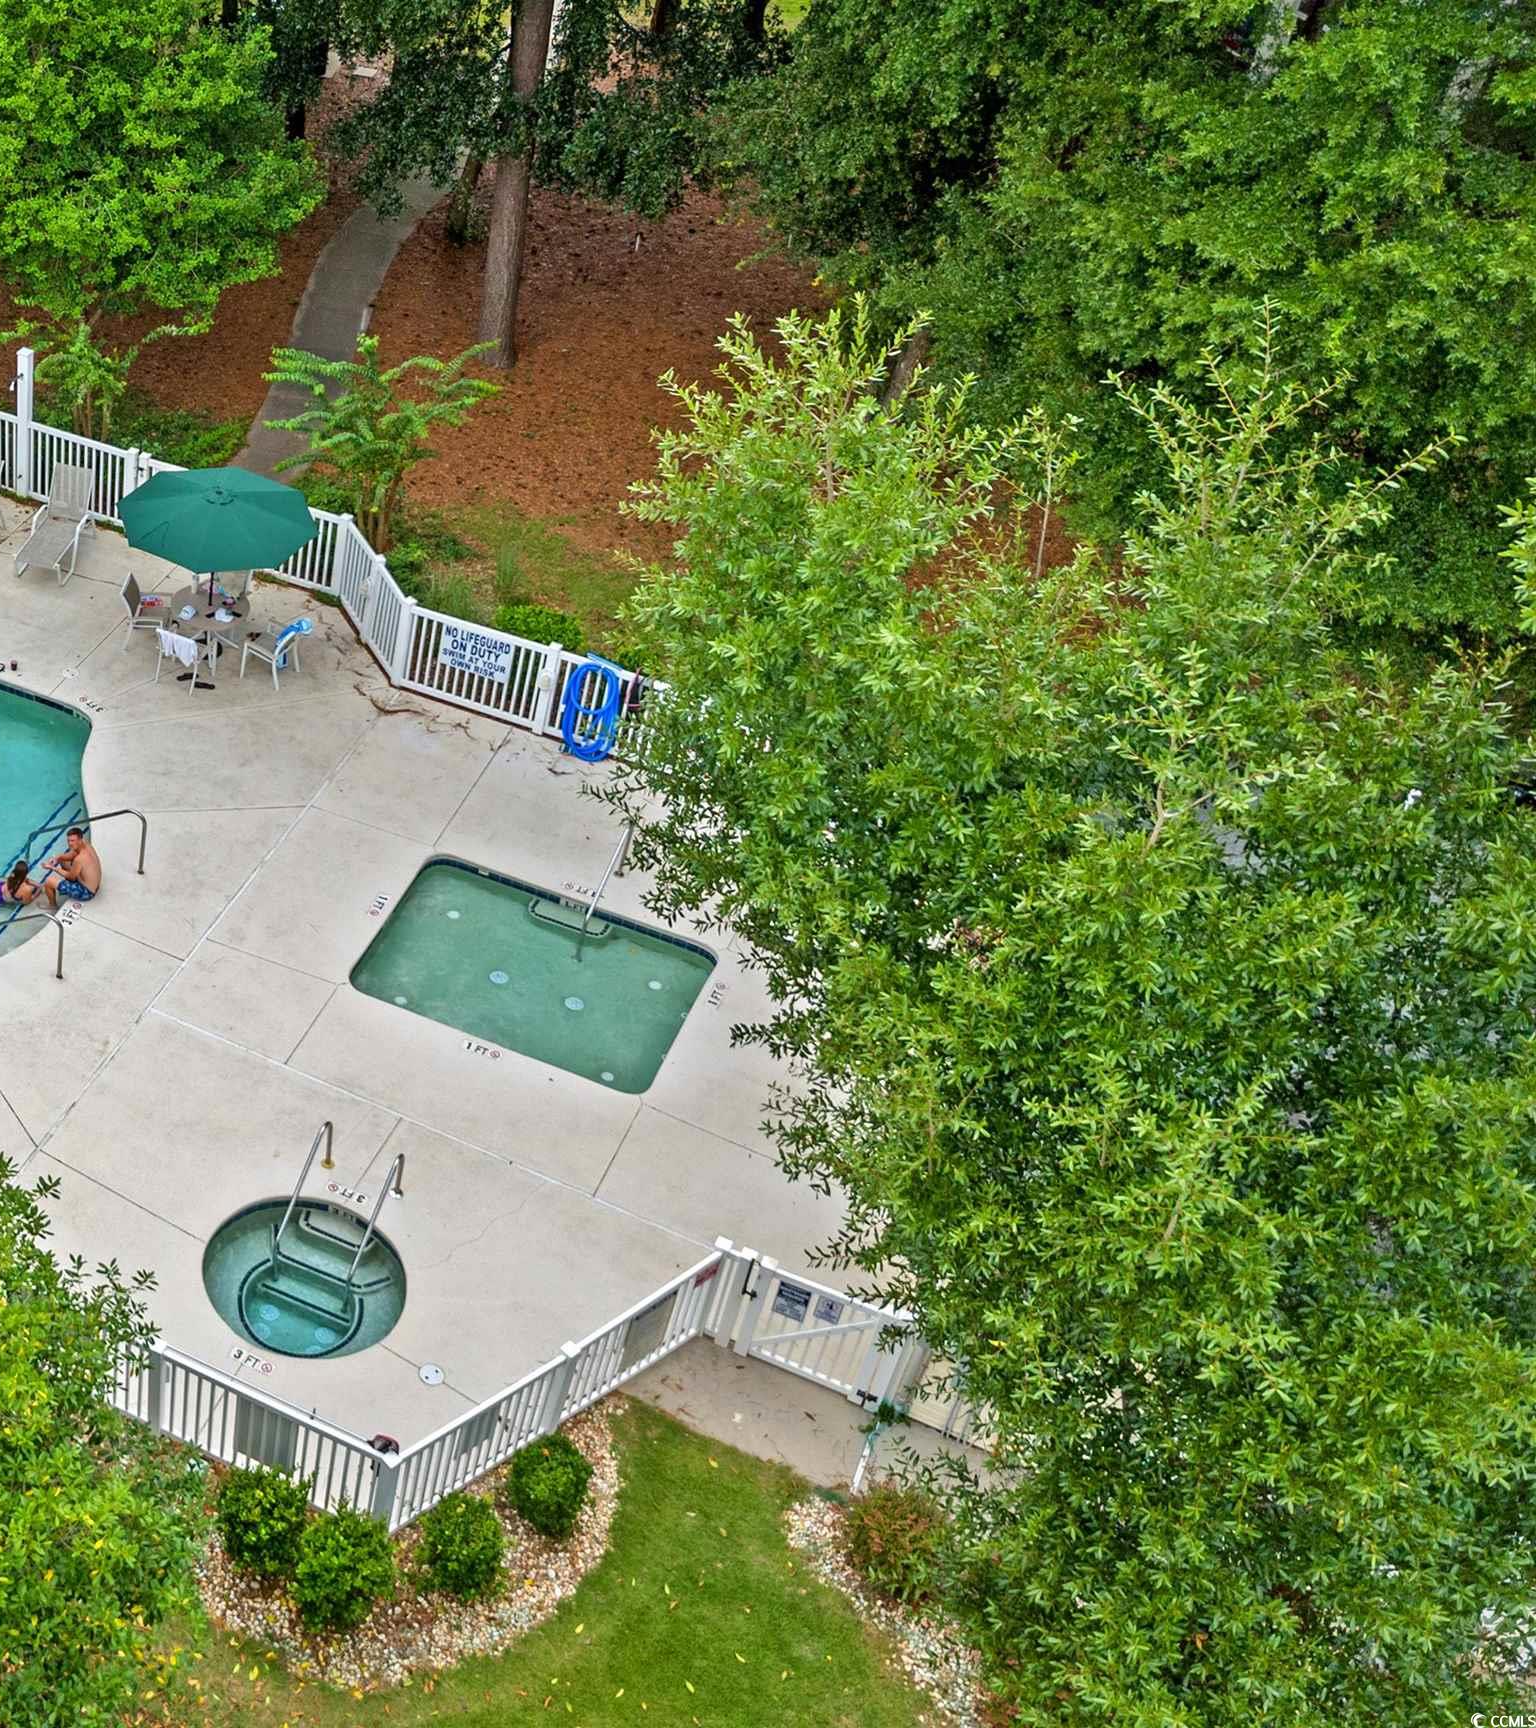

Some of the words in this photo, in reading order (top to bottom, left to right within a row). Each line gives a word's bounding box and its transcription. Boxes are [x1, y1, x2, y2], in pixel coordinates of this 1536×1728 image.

[445, 625, 458, 638] NO
[461, 630, 511, 654] LIFEGUARD
[442, 648, 465, 659] SWIM
[468, 656, 479, 665] AT
[482, 660, 506, 673] YOUR
[451, 639, 467, 652] ON
[471, 645, 501, 663] DUTY
[450, 659, 471, 670] OWN
[474, 666, 495, 678] RISK
[340, 1188, 354, 1199] FT
[234, 1349, 243, 1359] 3
[244, 1354, 260, 1368] FT
